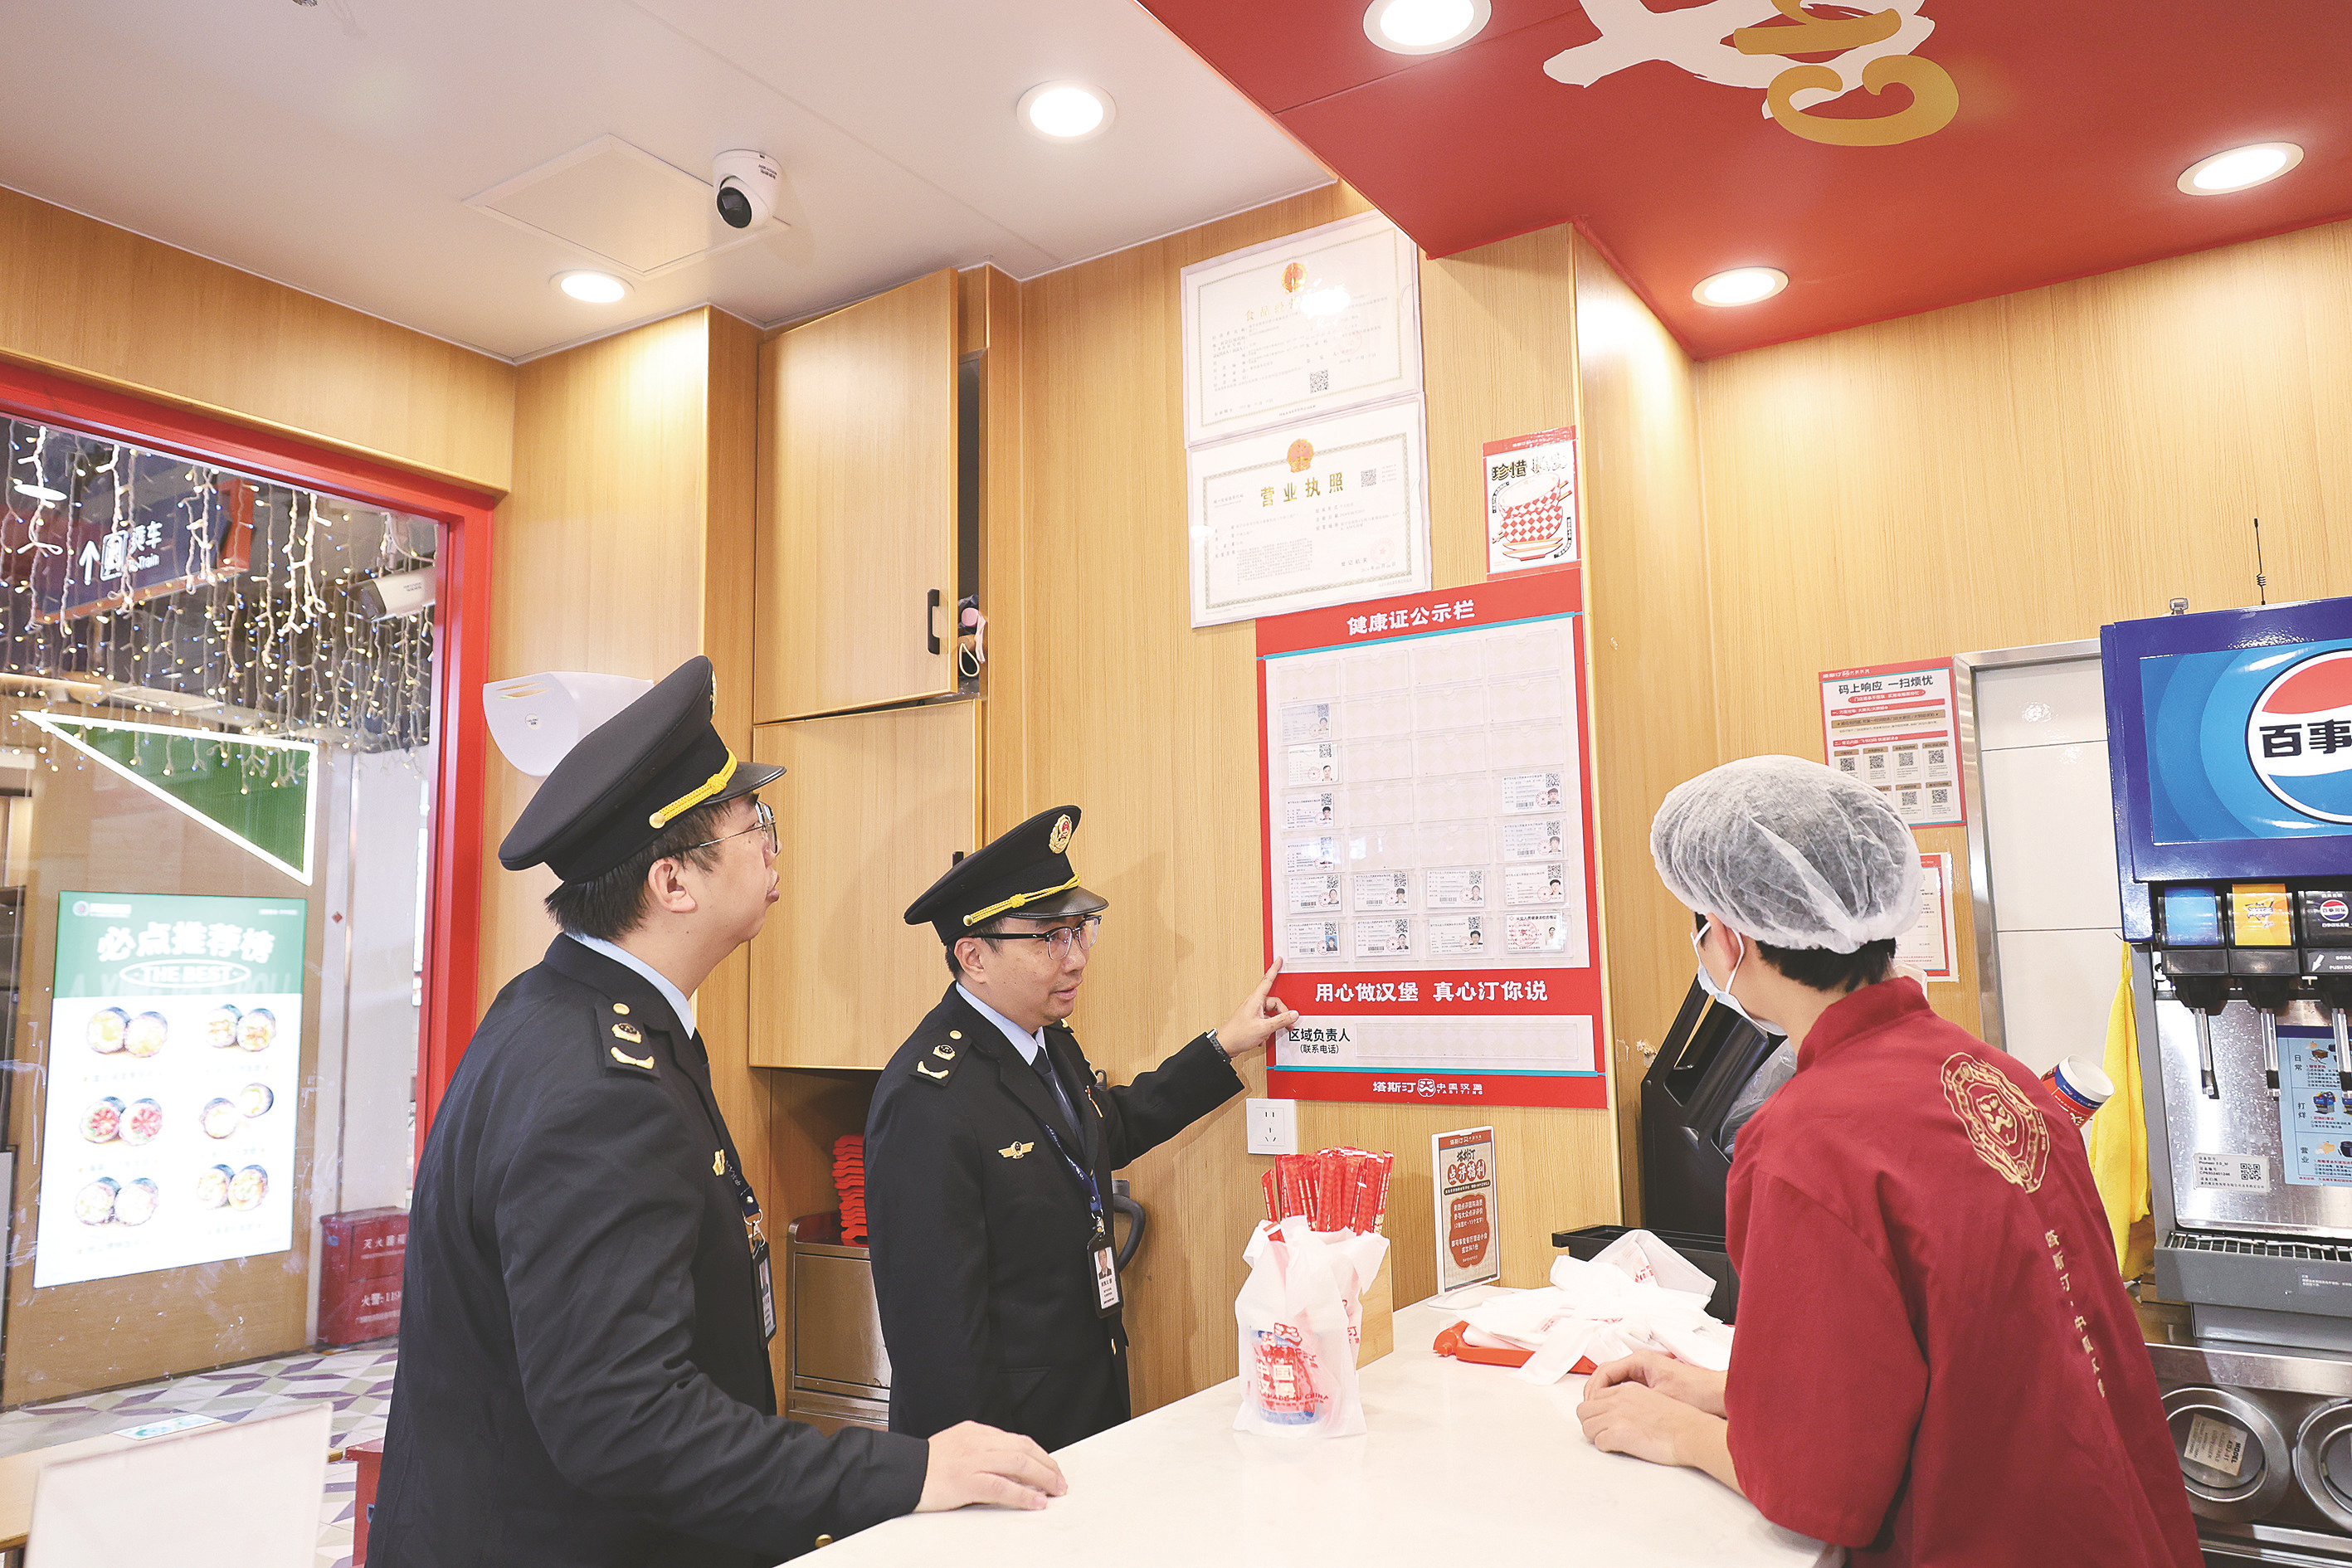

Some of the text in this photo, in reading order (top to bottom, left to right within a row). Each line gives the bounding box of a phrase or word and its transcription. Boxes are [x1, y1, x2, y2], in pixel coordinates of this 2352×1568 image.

[1492, 460, 1527, 480] 珍惜
[1259, 472, 1343, 507] 营业执照
[1346, 598, 1475, 636] 健康证公示栏
[1838, 675, 1934, 694] 码上响应 一扫烦忧
[2259, 718, 2352, 758] 百事
[140, 966, 231, 982] THE BEST
[1314, 980, 1548, 1002] 用心做汉堡 真心汀你说
[1289, 1027, 1351, 1043] 区域负责人
[2295, 1054, 2302, 1071] 日常
[1372, 1081, 1416, 1093] 塔斯汀
[2301, 1147, 2309, 1163] 营业
[1449, 1160, 1484, 1183] 点评福利
[2231, 1442, 2242, 1463] MODEL
